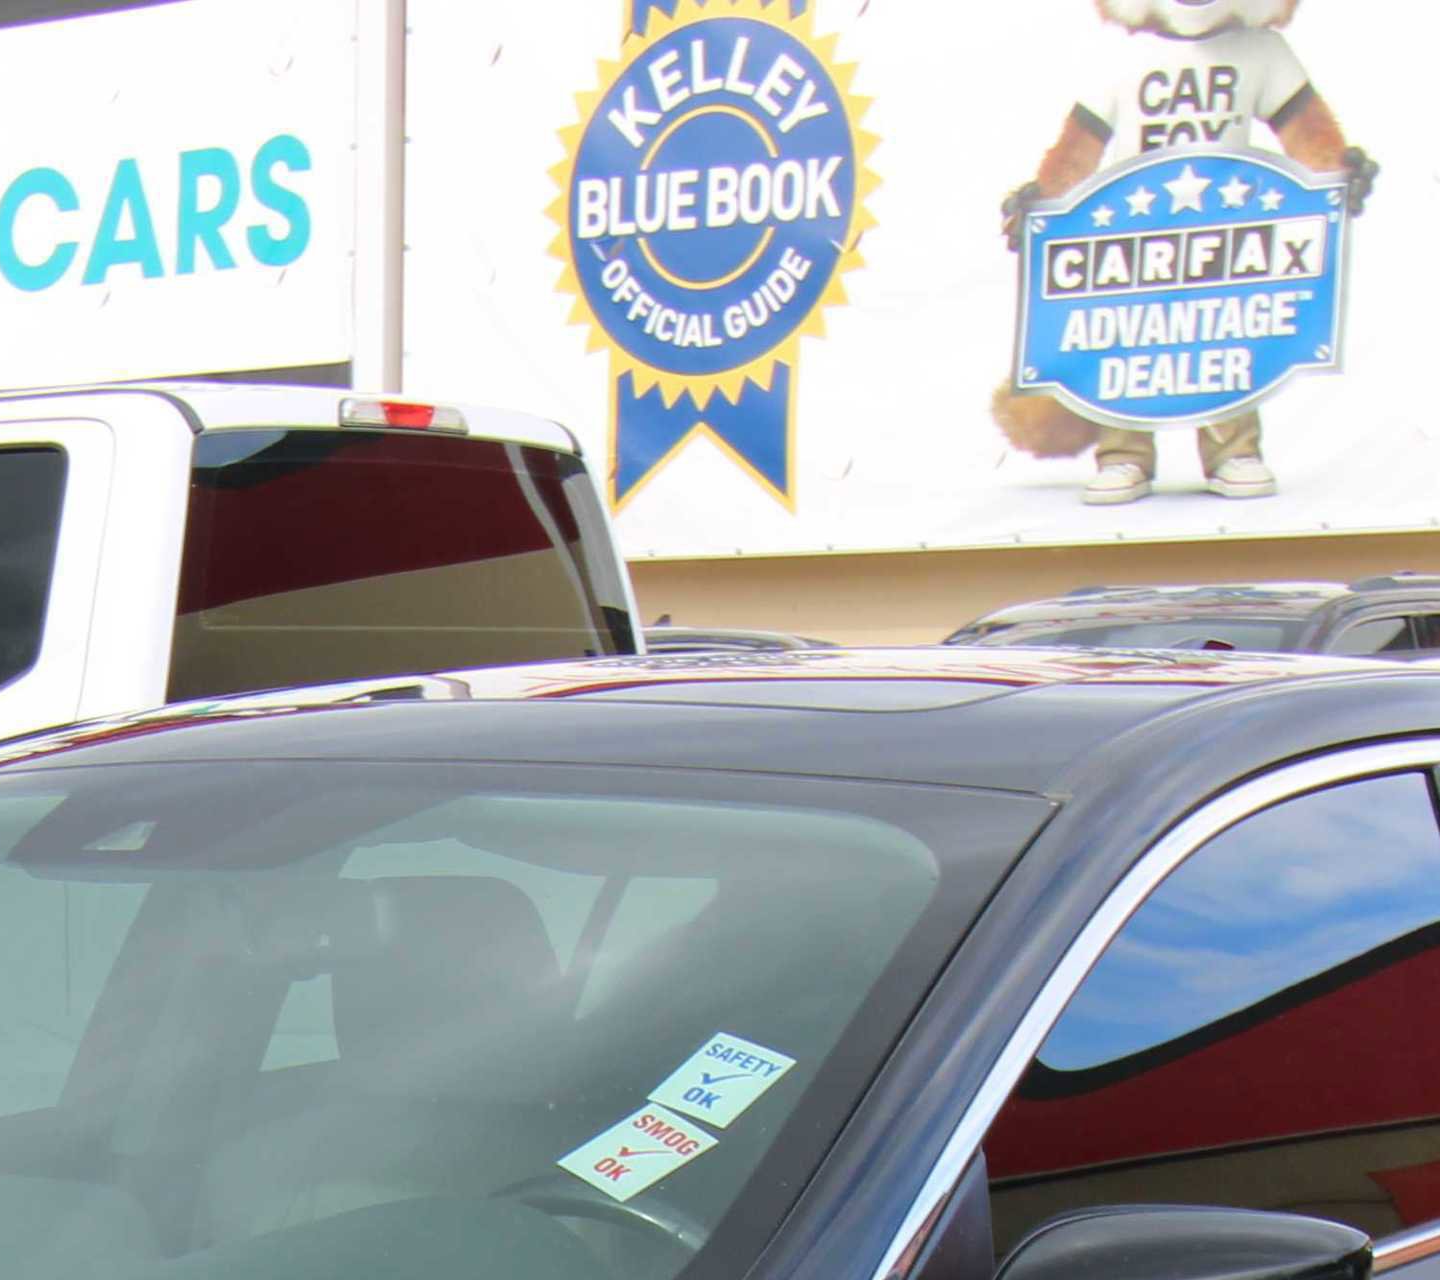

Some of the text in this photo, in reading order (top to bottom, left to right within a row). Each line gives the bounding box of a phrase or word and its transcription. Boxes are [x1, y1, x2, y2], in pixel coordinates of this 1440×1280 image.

[608, 36, 830, 148] KELLEY
[1138, 65, 1240, 116] CAR
[577, 156, 843, 239] BLUE BOOK
[1052, 231, 1313, 290] CARFAX
[601, 246, 813, 348] OFFICIAL GUIDE
[1096, 347, 1252, 401] DEALER
[705, 1042, 782, 1078] SAFETY
[682, 1086, 722, 1110] OK
[632, 1114, 701, 1158] SMOG
[592, 1156, 632, 1182] OK
